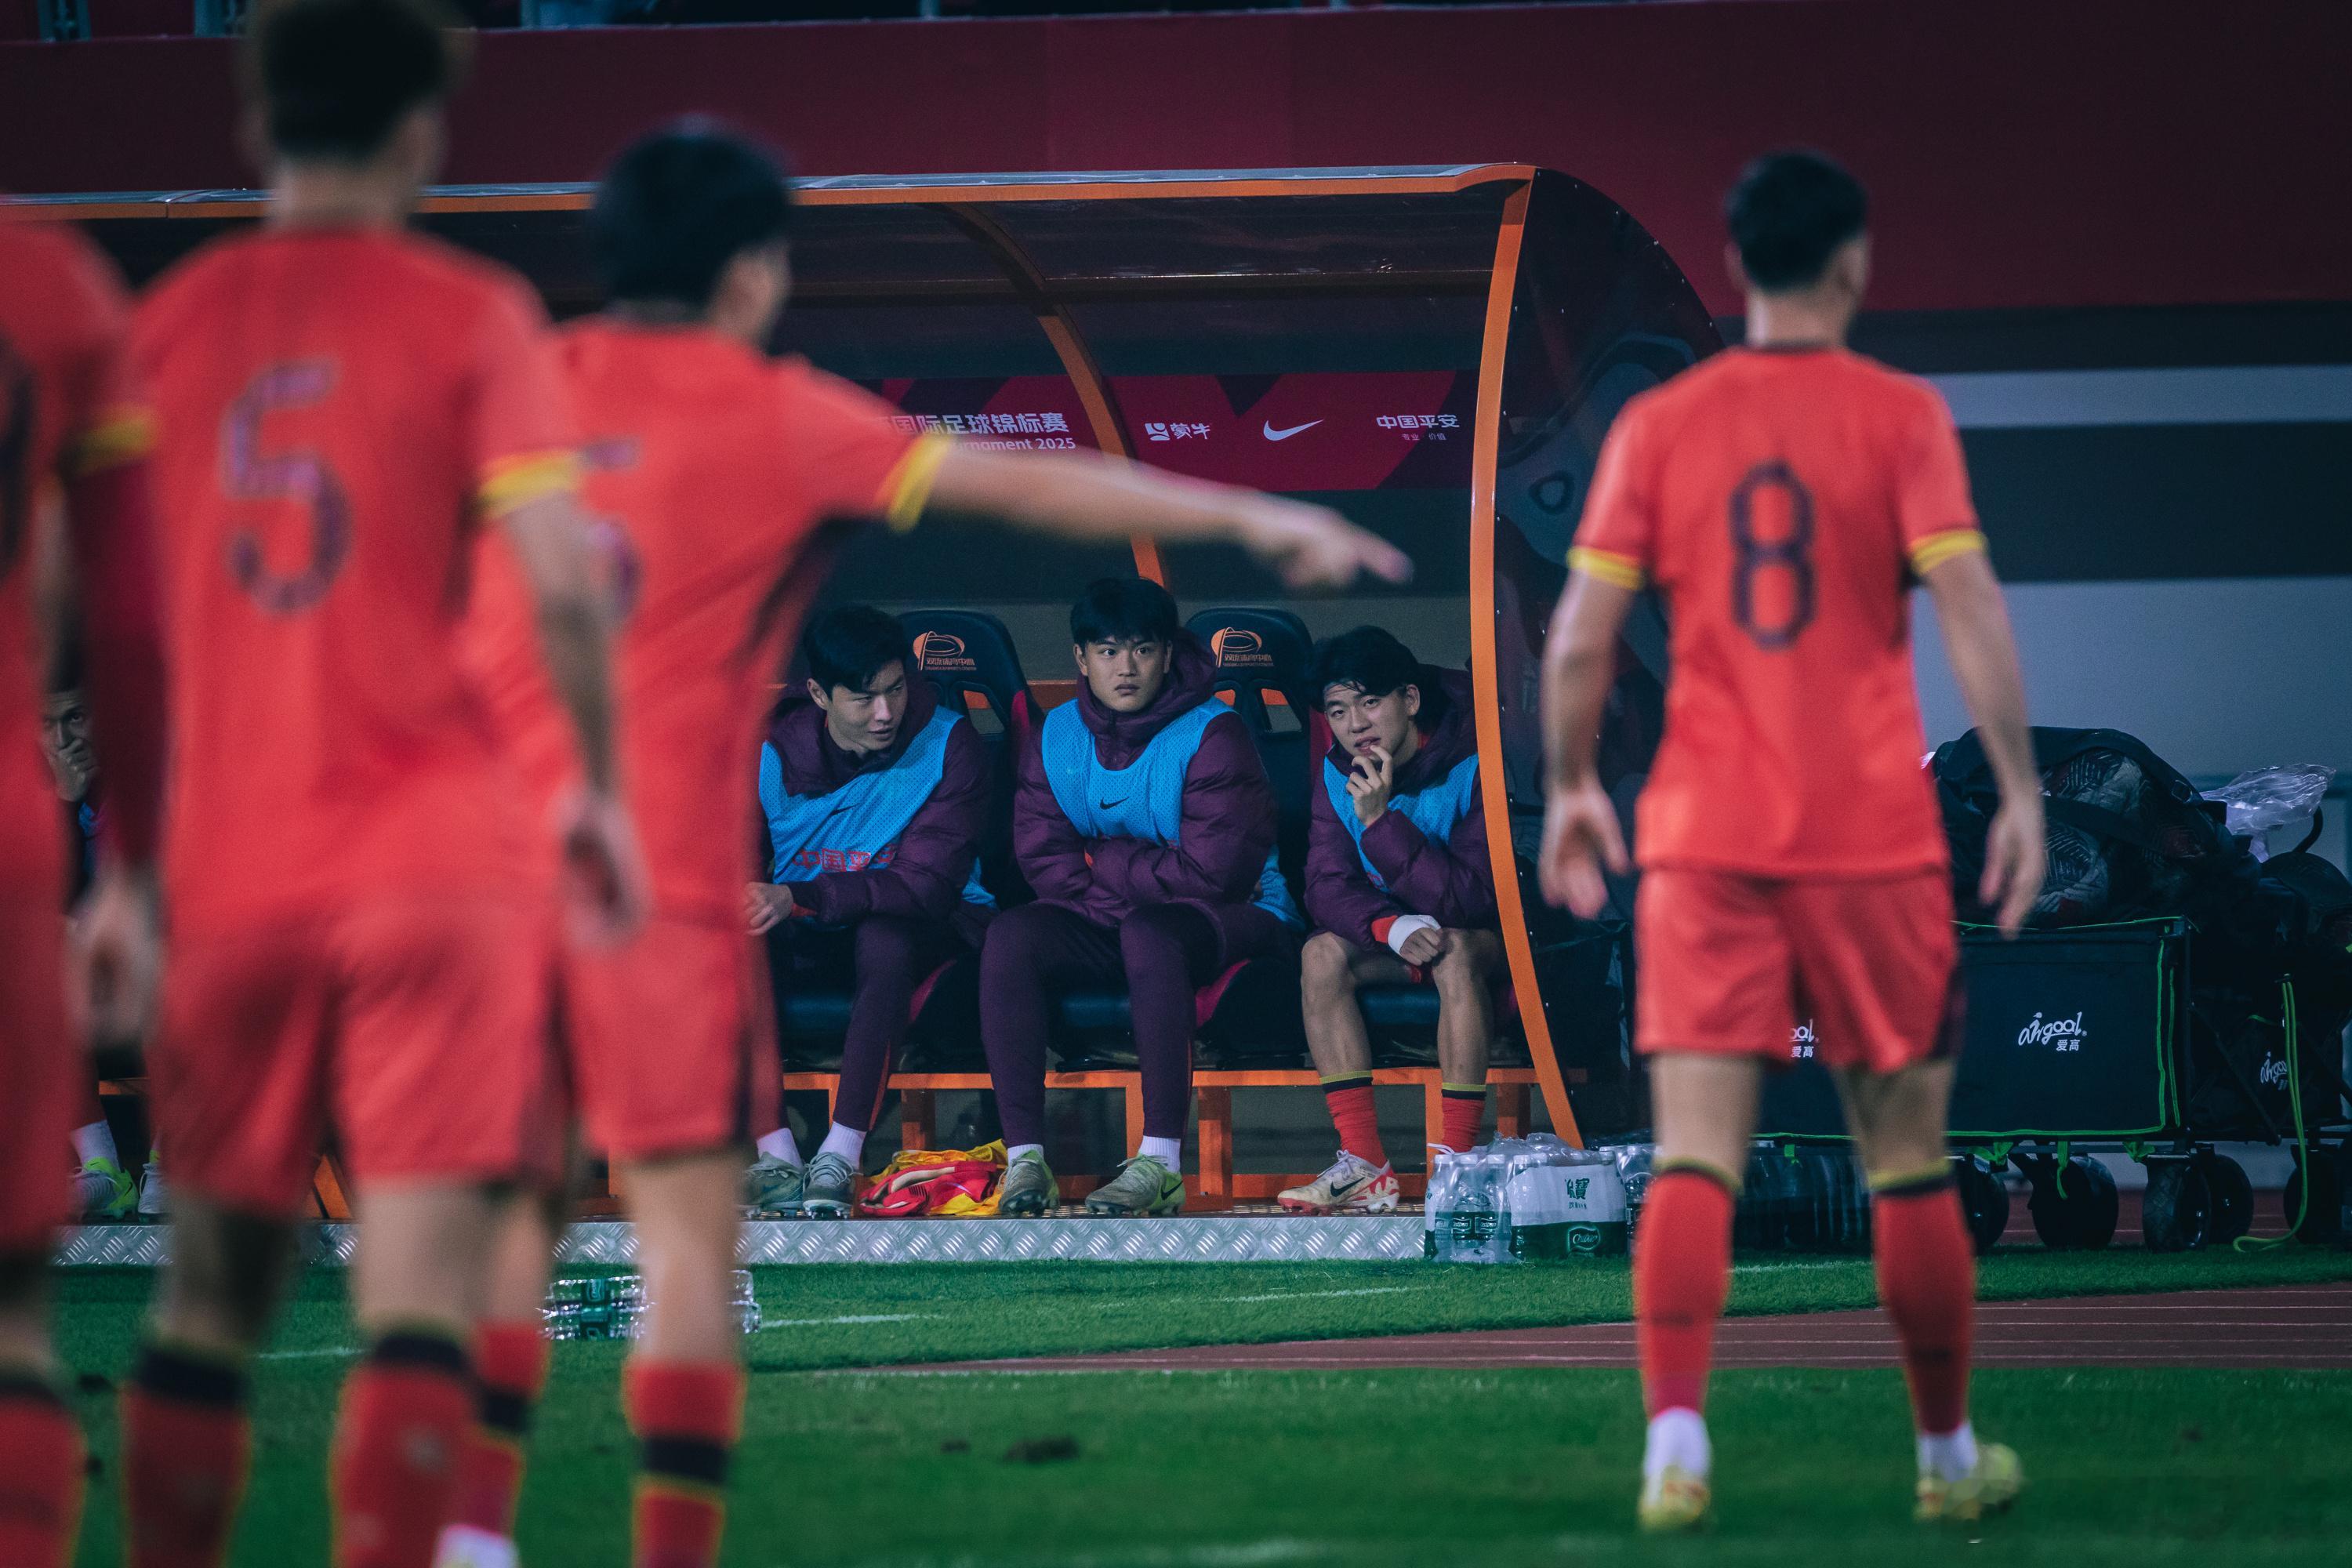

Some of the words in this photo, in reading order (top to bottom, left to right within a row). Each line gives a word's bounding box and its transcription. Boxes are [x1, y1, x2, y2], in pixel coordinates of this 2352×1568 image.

[877, 412, 1069, 434] 国际足球锦标赛
[1376, 414, 1460, 429] 中国平安
[1170, 423, 1210, 440] 蒙牛
[1036, 437, 1076, 449] 2025
[218, 359, 352, 614] 5
[1730, 456, 1817, 652] 8
[2018, 1011, 2082, 1046] airgoal
[1791, 1046, 1814, 1058] 爱高
[2056, 1039, 2080, 1051] 爱高
